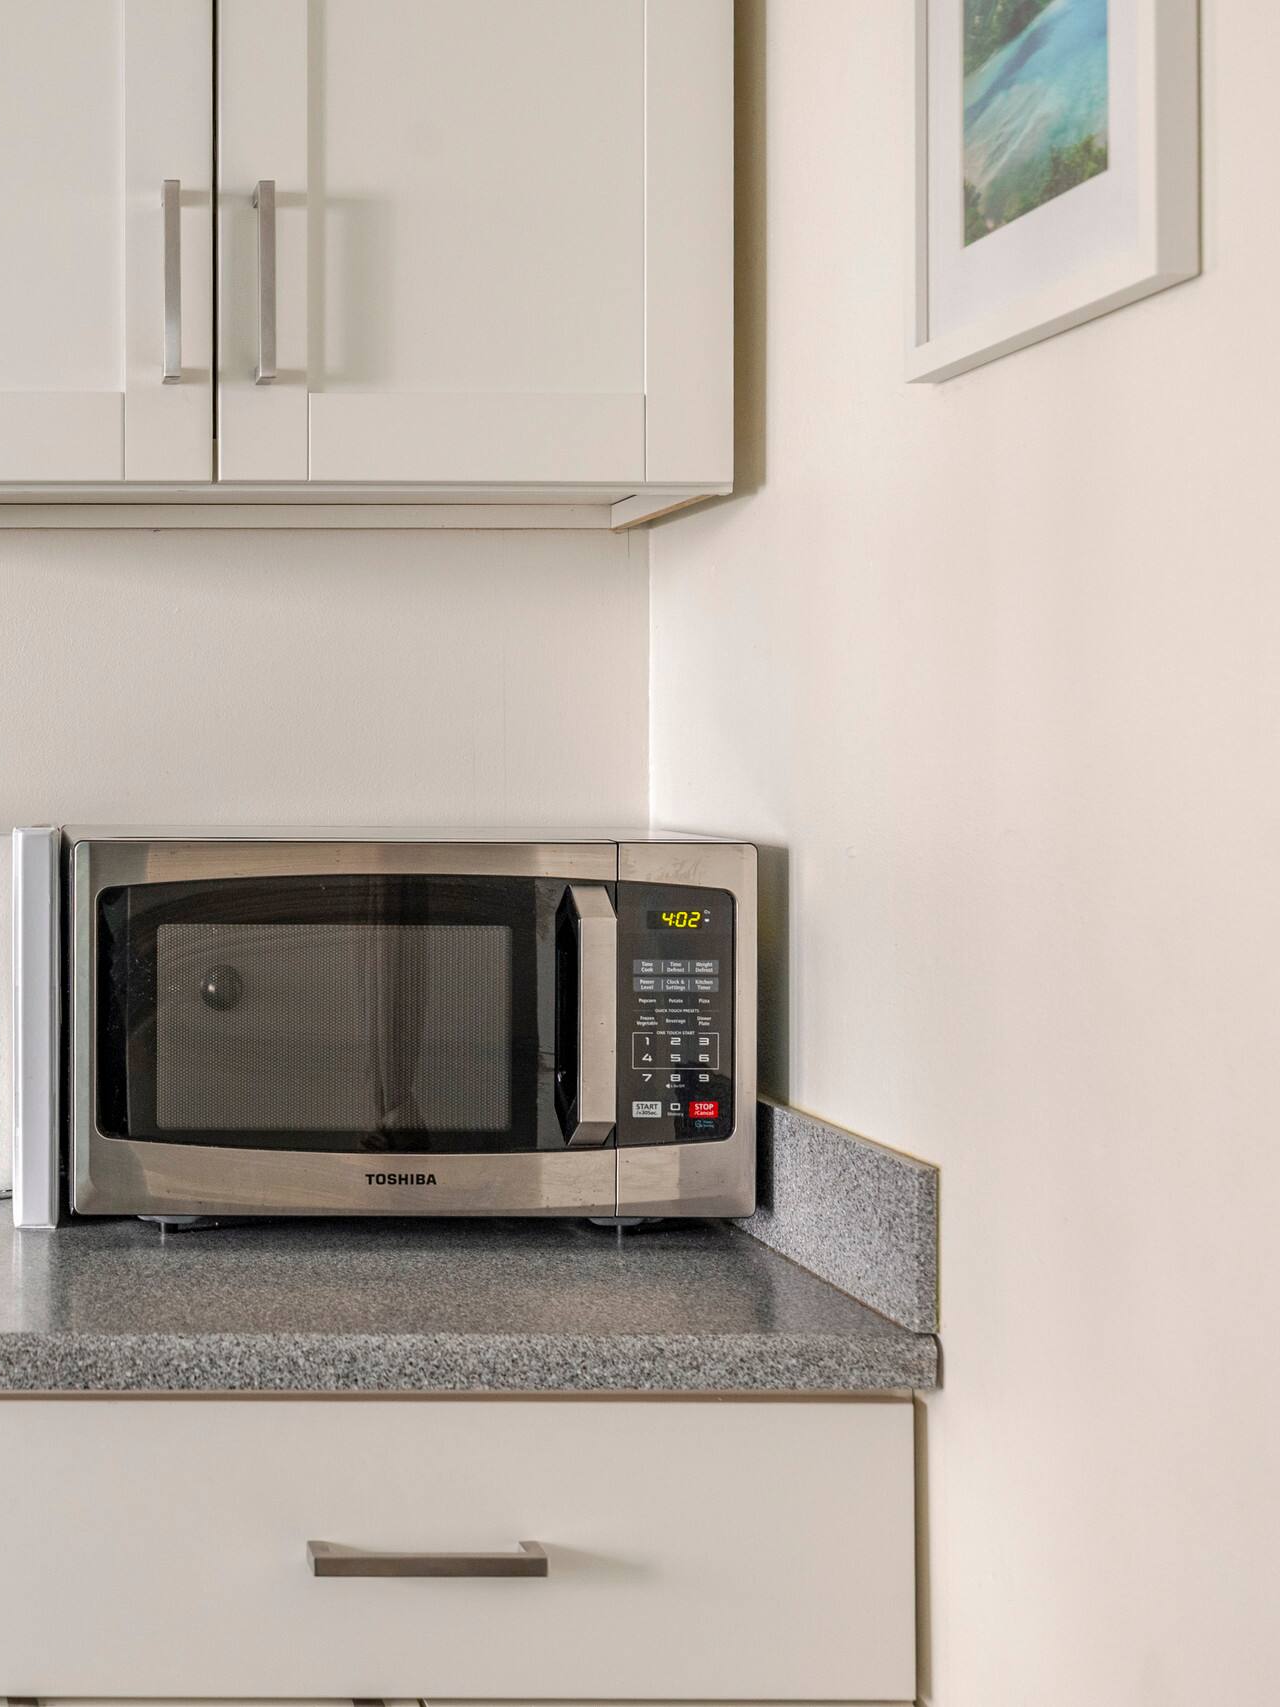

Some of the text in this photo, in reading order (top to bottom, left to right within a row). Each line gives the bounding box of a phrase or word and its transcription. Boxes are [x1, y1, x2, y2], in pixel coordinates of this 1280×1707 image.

[662, 911, 701, 928] 4:02
[645, 1037, 650, 1046] 1
[670, 1037, 681, 1045] 2
[698, 1037, 710, 1046] 3
[642, 1053, 653, 1062] 4
[670, 1054, 681, 1062] 5
[698, 1054, 710, 1062] 6
[642, 1074, 653, 1082] 7
[670, 1074, 681, 1082] 8
[698, 1074, 710, 1082] 9
[670, 1103, 680, 1111] 0
[365, 1173, 437, 1185] TOSHIBA
